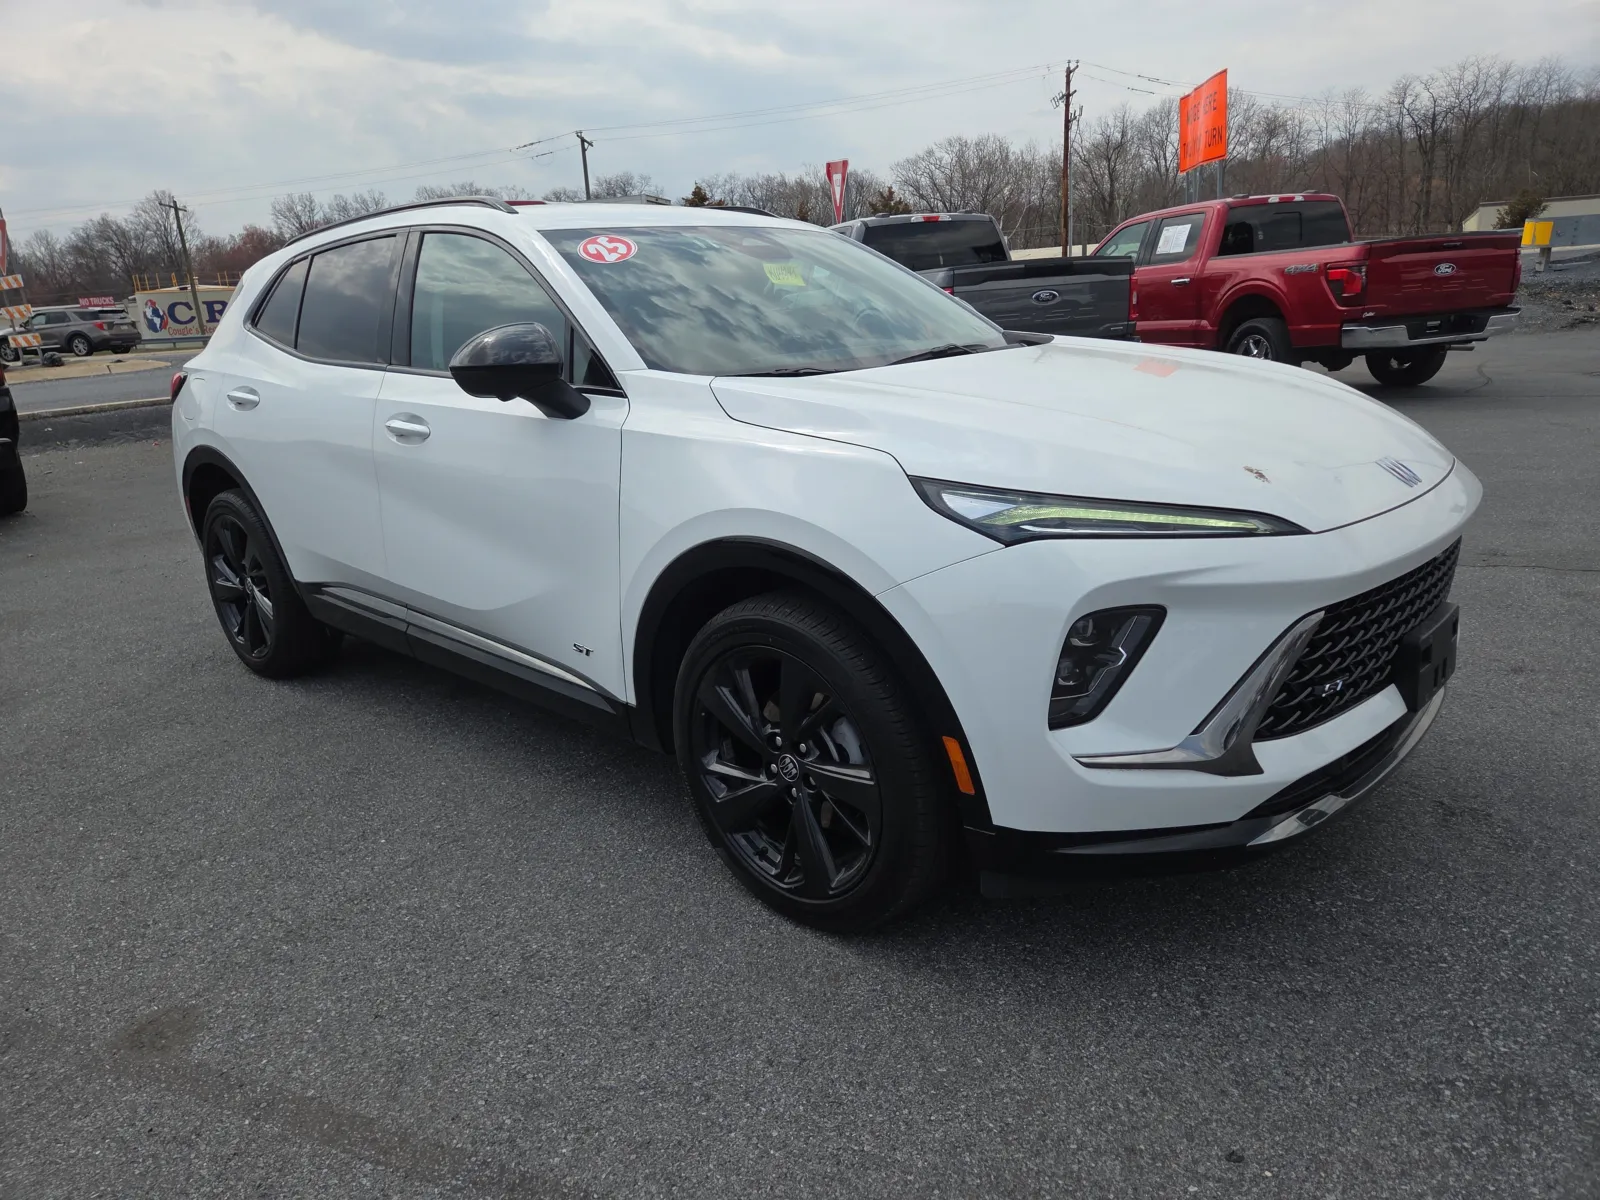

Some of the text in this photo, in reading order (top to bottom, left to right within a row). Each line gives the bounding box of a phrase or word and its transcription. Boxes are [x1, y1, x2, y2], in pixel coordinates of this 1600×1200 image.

[1205, 125, 1223, 149] TURN
[587, 236, 627, 261] 25
[79, 296, 115, 306] NO TRUCKS
[167, 326, 200, 336] Cougle's
[572, 642, 594, 657] ST
